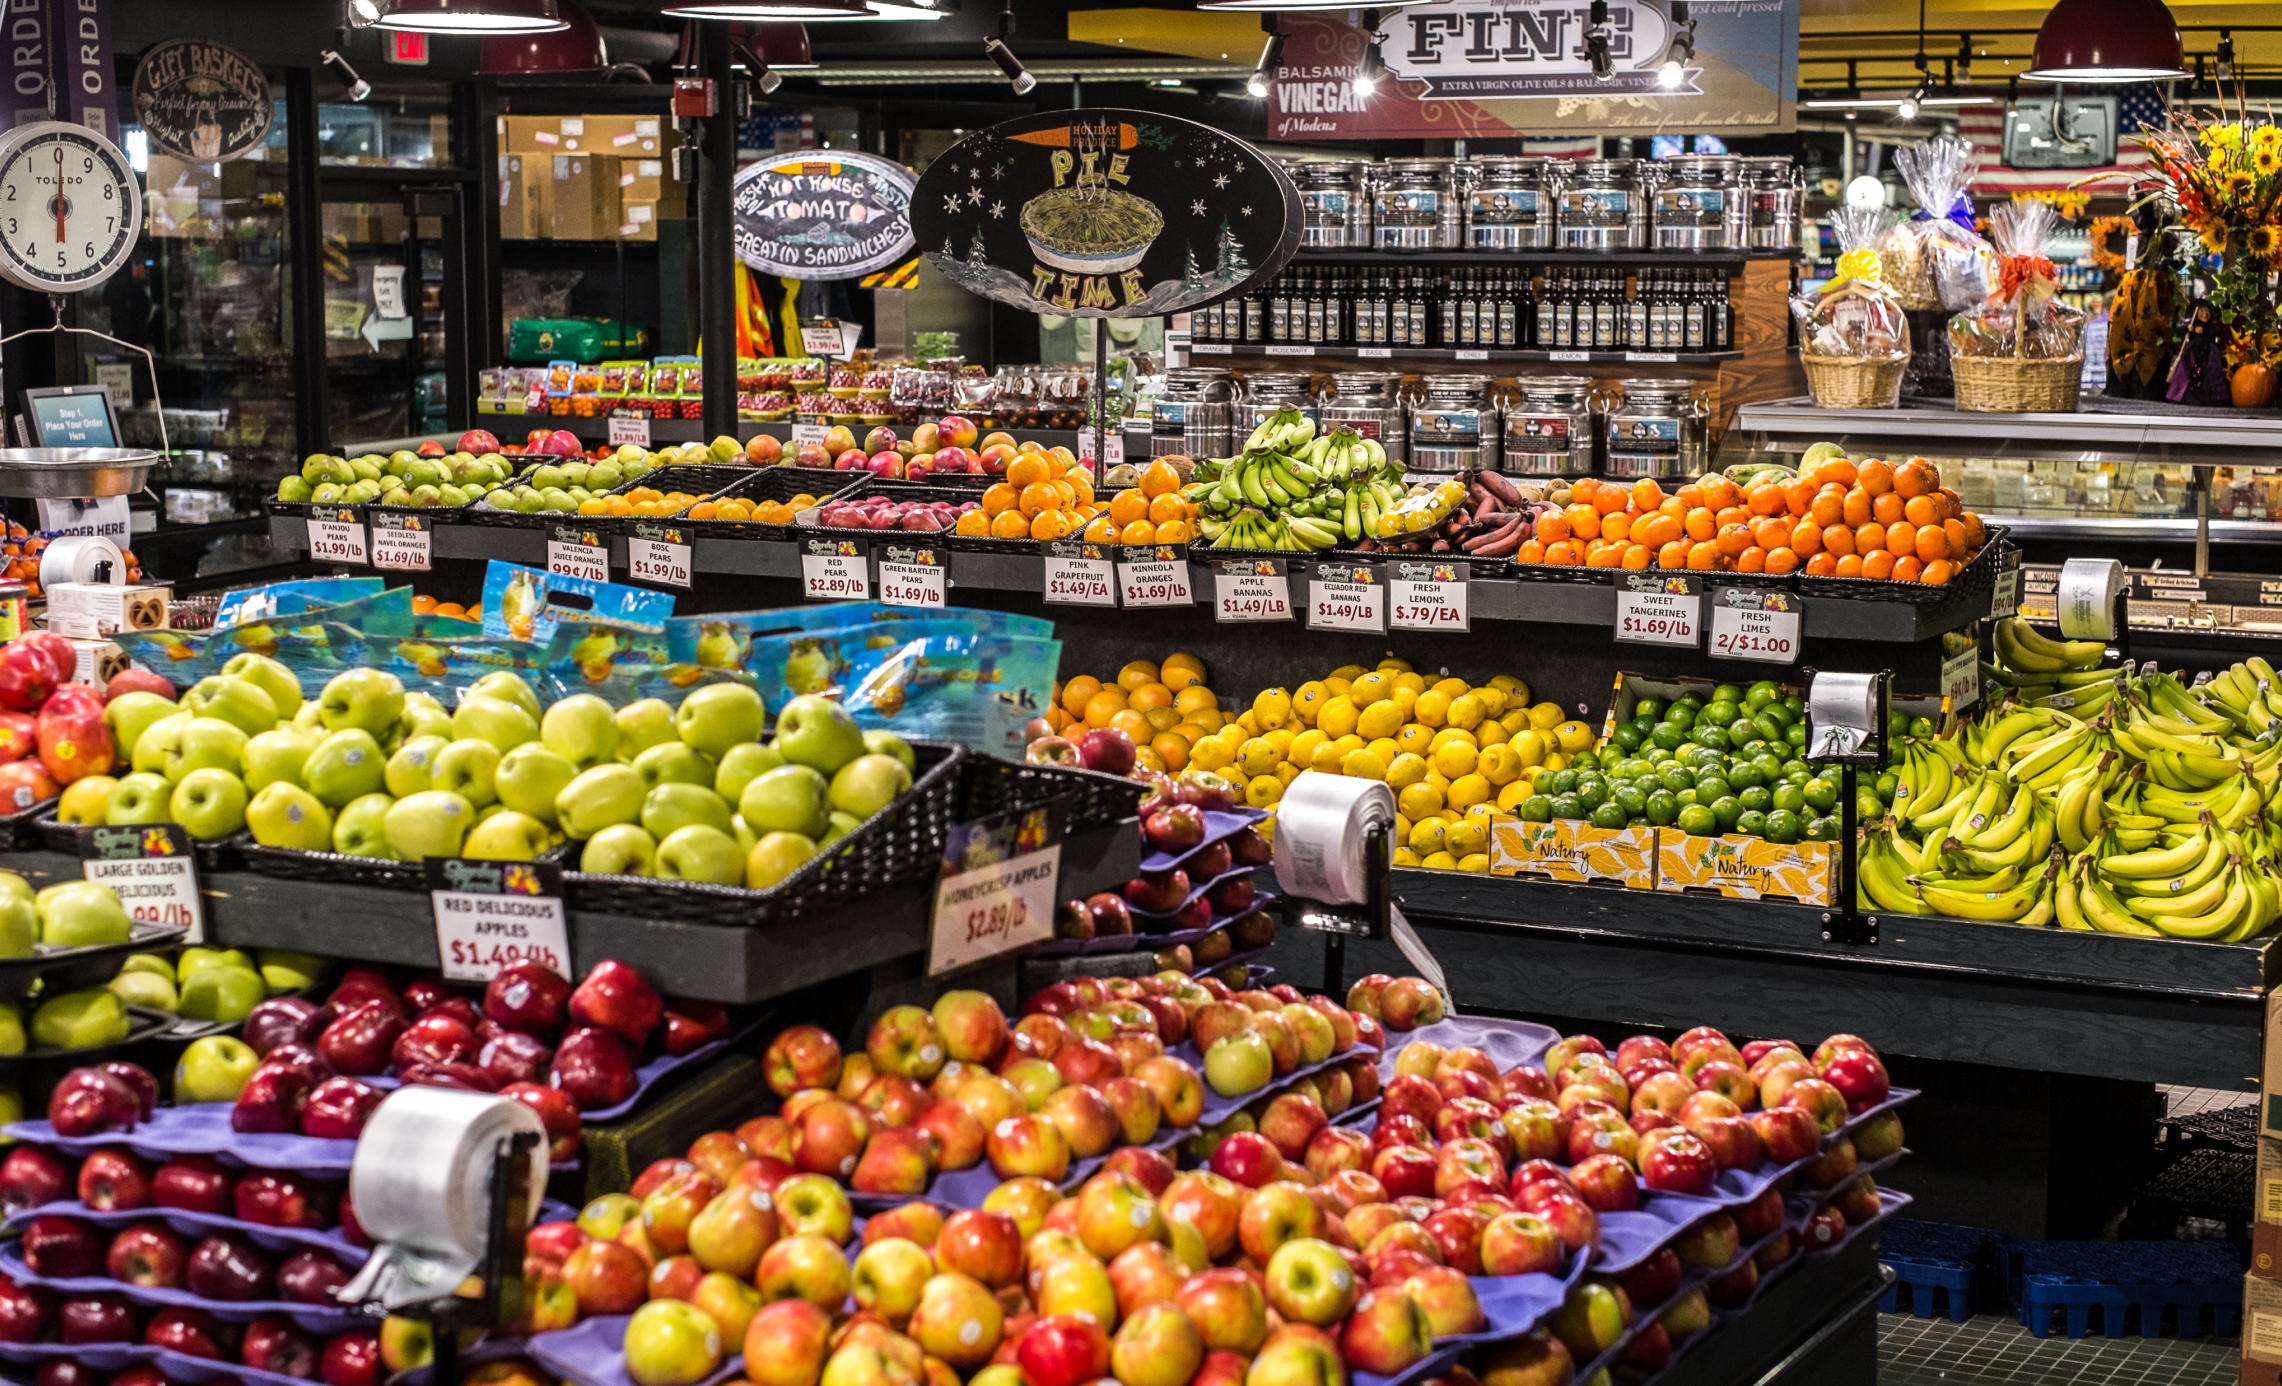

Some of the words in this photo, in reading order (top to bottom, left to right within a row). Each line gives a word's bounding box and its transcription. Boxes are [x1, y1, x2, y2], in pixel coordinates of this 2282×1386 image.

[1737, 1, 1783, 18] pressed
[1407, 7, 1633, 64] FINE
[147, 45, 186, 89] GIFT
[190, 45, 262, 100] BASKETS
[1442, 81, 1475, 91] EXTRA
[1476, 80, 1510, 90] VIRGIN
[1511, 79, 1542, 89] OLIVE
[1543, 79, 1566, 88] OILS
[1567, 79, 1575, 88] &
[1743, 110, 1778, 125] World
[1073, 125, 1117, 136] HOLIDAY
[1278, 118, 1291, 137] of
[1290, 118, 1336, 132] Modena
[1073, 137, 1116, 148] PRODUCE
[54, 147, 63, 164] 0
[84, 157, 93, 173] 9
[1051, 150, 1131, 187] PIE
[7, 185, 16, 201] 2
[104, 184, 113, 200] 8
[774, 199, 867, 223] TOMATO
[8, 218, 18, 234] 3
[106, 216, 115, 233] 7
[27, 242, 37, 258] 4
[85, 242, 95, 258] 6
[57, 251, 66, 267] 5
[1031, 264, 1149, 311] TIME
[59, 408, 76, 419] Step
[45, 421, 65, 431] Place
[65, 420, 82, 430] Your
[83, 419, 103, 429] Order
[69, 432, 86, 441] Here
[96, 522, 125, 535] HERE
[322, 523, 350, 533] D'ANJOU
[386, 531, 417, 540] SEEDLESS
[327, 533, 348, 542] PEARS
[378, 539, 398, 548] NAVEL
[398, 540, 427, 550] ORANGES
[314, 541, 362, 559] $1.99/lb
[562, 544, 594, 555] VALENCIA
[651, 543, 670, 552] BOSC
[377, 549, 425, 567] $1.69/lb
[553, 552, 572, 562] JUICE
[574, 555, 604, 566] ORANGES
[649, 553, 672, 563] PEARS
[827, 558, 842, 567] RED
[1069, 561, 1089, 570] PINK
[552, 563, 604, 581] 99¢/lb
[635, 561, 686, 581] $1.99/lb
[824, 568, 848, 577] PEARS
[884, 564, 907, 574] GREEN
[908, 566, 940, 576] BARTLETT
[1055, 571, 1104, 581] GRAPEFRUIT
[1131, 563, 1175, 573] MINNEOLA
[810, 578, 864, 595] $2.89/lb
[901, 575, 923, 584] PEARS
[1135, 574, 1173, 584] ORANGES
[1239, 578, 1265, 586] APPLE
[885, 585, 940, 604] $1.69/lb
[1050, 580, 1108, 599] $1.49/EA
[1127, 584, 1187, 601] $1.69/lb
[1233, 589, 1273, 597] BANANAS
[1324, 583, 1353, 592] ECUADOR
[1354, 585, 1368, 593] RED
[1413, 583, 1441, 592] FRESH
[1330, 593, 1361, 602] BANANAS
[1409, 595, 1445, 604] LEMONS
[1643, 595, 1674, 605] SWEET
[1223, 598, 1285, 616] $1.49/LB
[1318, 602, 1373, 621] $1.49/LB
[1396, 605, 1460, 625] $.79/EA
[1629, 607, 1687, 618] TANGERINES
[1741, 612, 1771, 622] FRESH
[1623, 616, 1691, 639] $1.69/lb
[1741, 624, 1771, 634] LIMES
[1718, 633, 1790, 653] 2/$1.00
[1540, 839, 1591, 875] Natury
[94, 863, 135, 878] LARGE
[136, 862, 186, 877] GOLDEN
[1013, 861, 1053, 886] APPLES
[1718, 856, 1773, 893] Natury
[444, 898, 472, 912] RED
[477, 900, 554, 919] DELICIOUS
[966, 896, 1027, 944] $2.89/lb
[475, 922, 529, 938] APPLES
